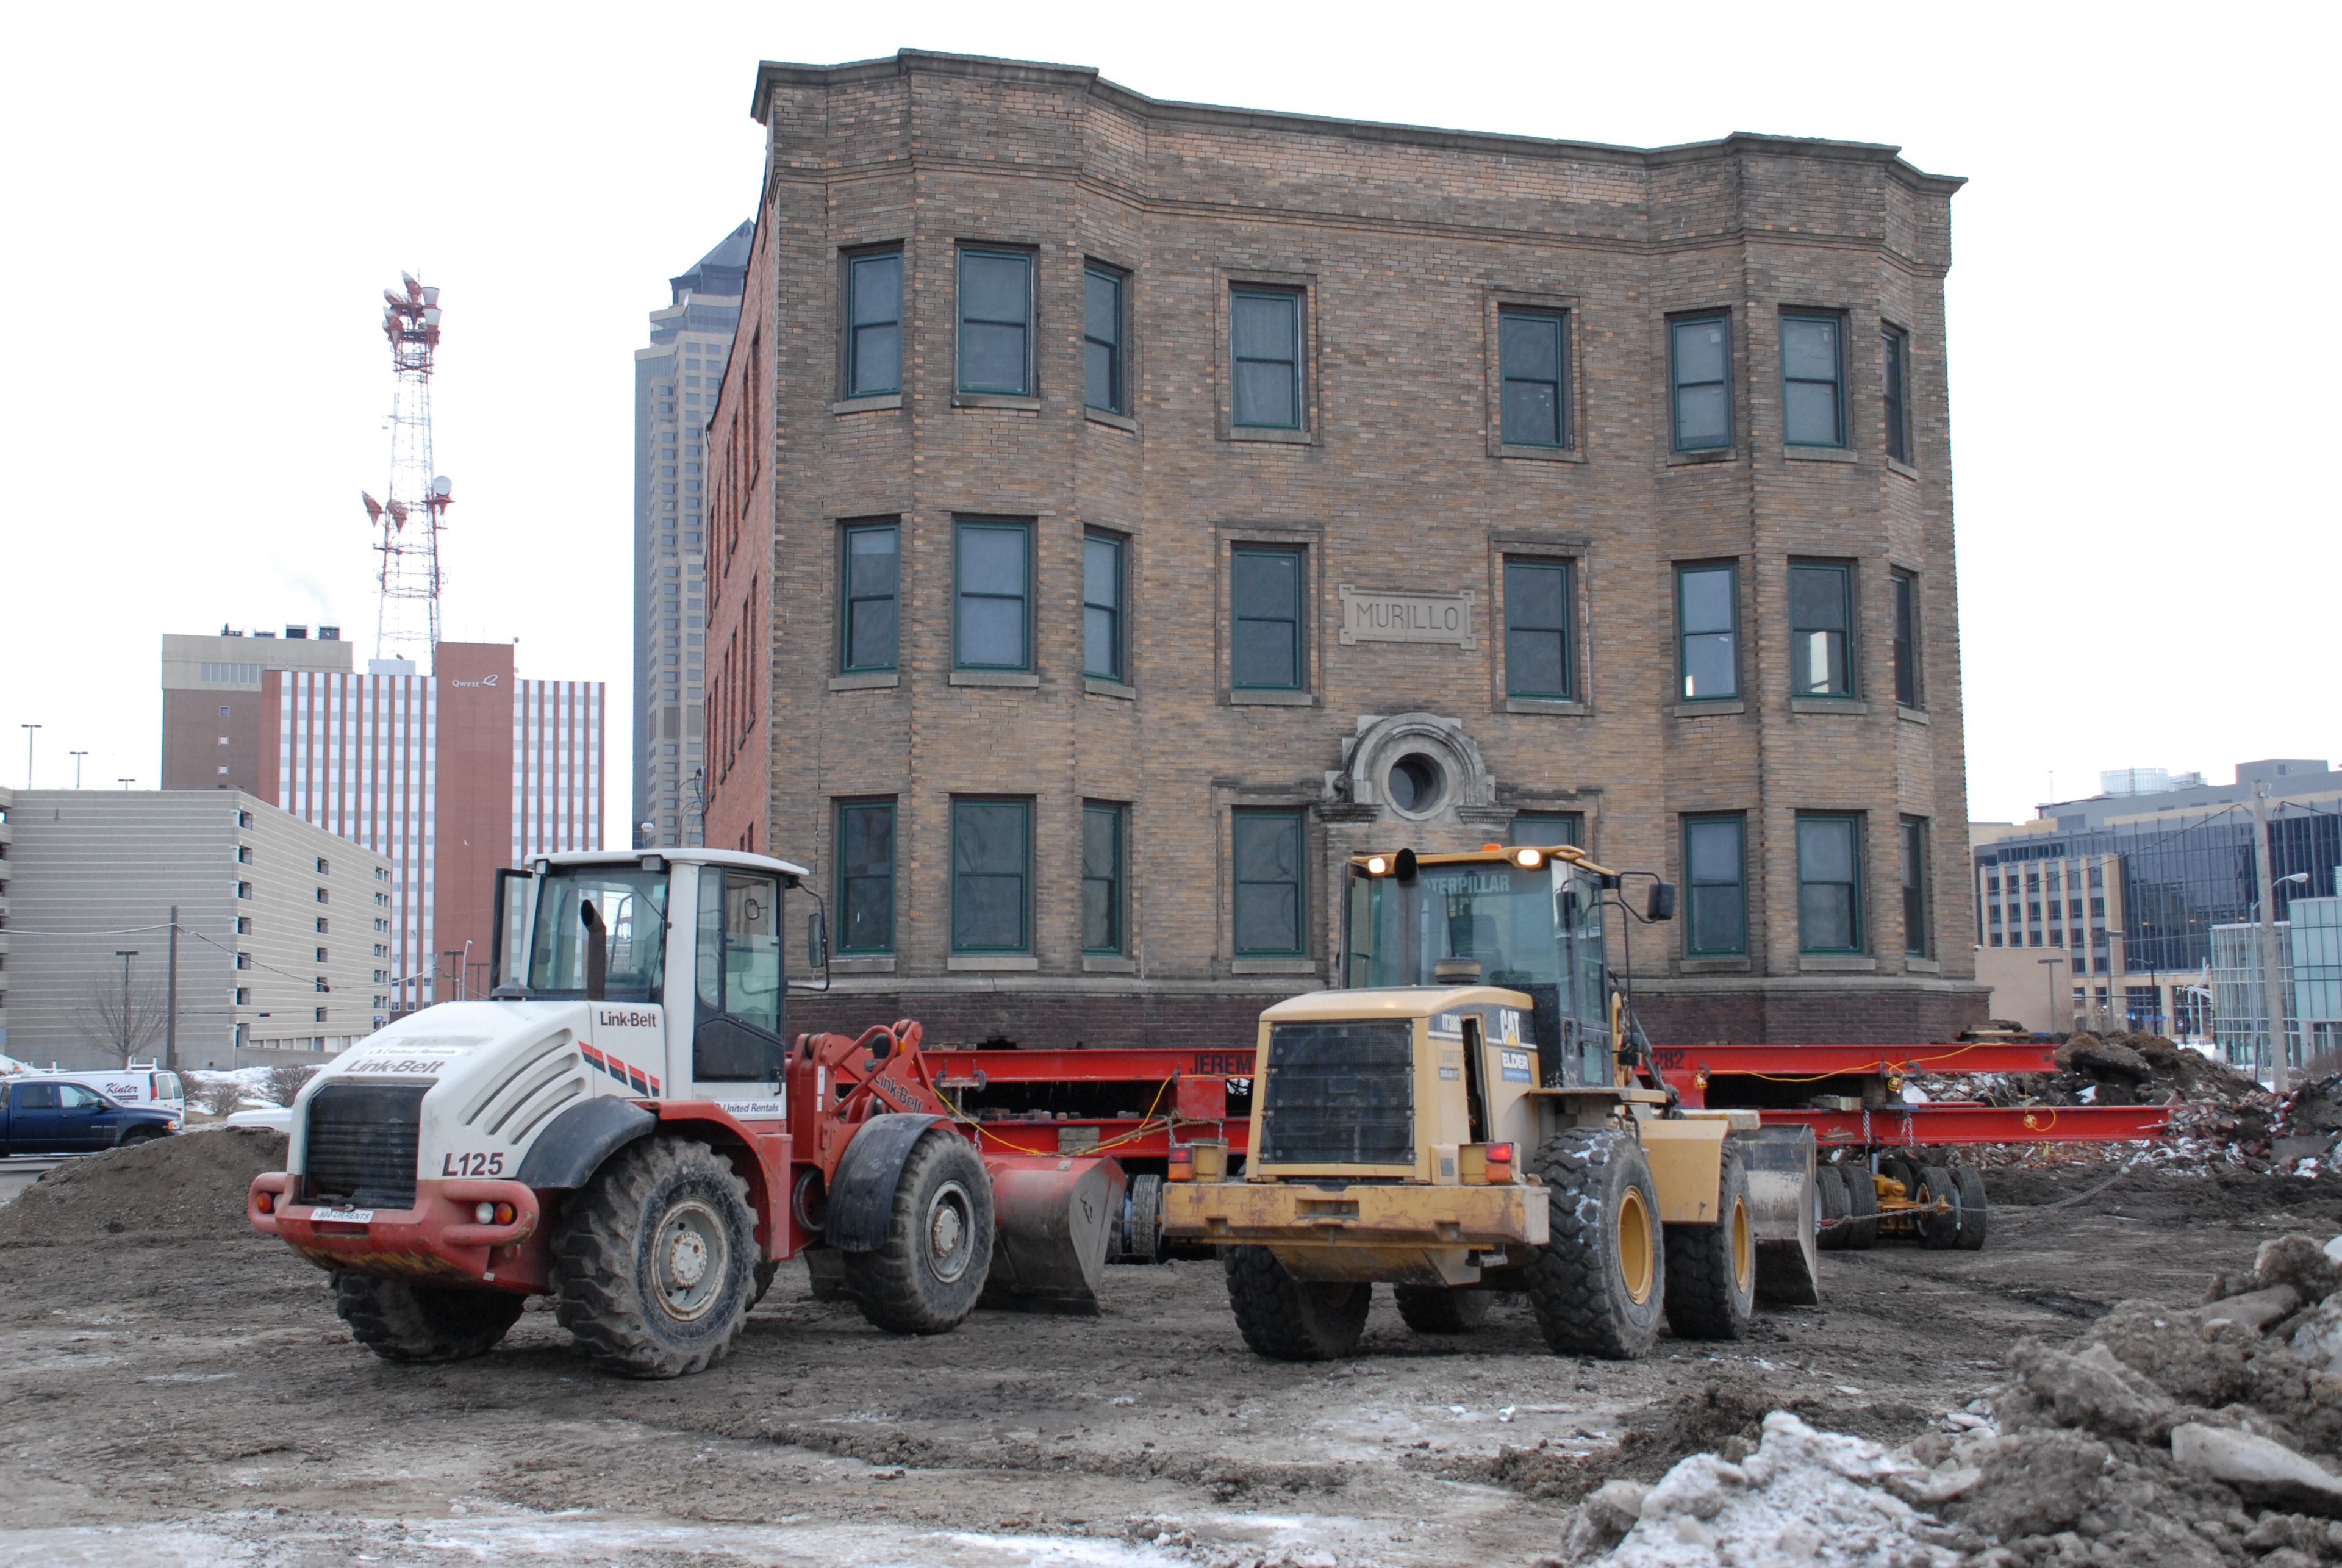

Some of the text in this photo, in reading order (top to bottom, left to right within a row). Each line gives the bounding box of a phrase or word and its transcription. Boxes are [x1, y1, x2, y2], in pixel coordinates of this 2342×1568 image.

[1356, 603, 1458, 631] MURILLO
[452, 679, 479, 688] Qwest
[1423, 875, 1509, 895] ATERPILLAR
[600, 1011, 657, 1027] Link-Belt
[1500, 1008, 1520, 1045] CAT
[343, 1059, 445, 1073] Link-Belt
[1189, 1054, 1256, 1075] JEREM
[1502, 1052, 1530, 1070] ELDER
[106, 1083, 138, 1094] Kinter
[723, 1103, 779, 1112] United Rentals
[442, 1152, 505, 1176] L125
